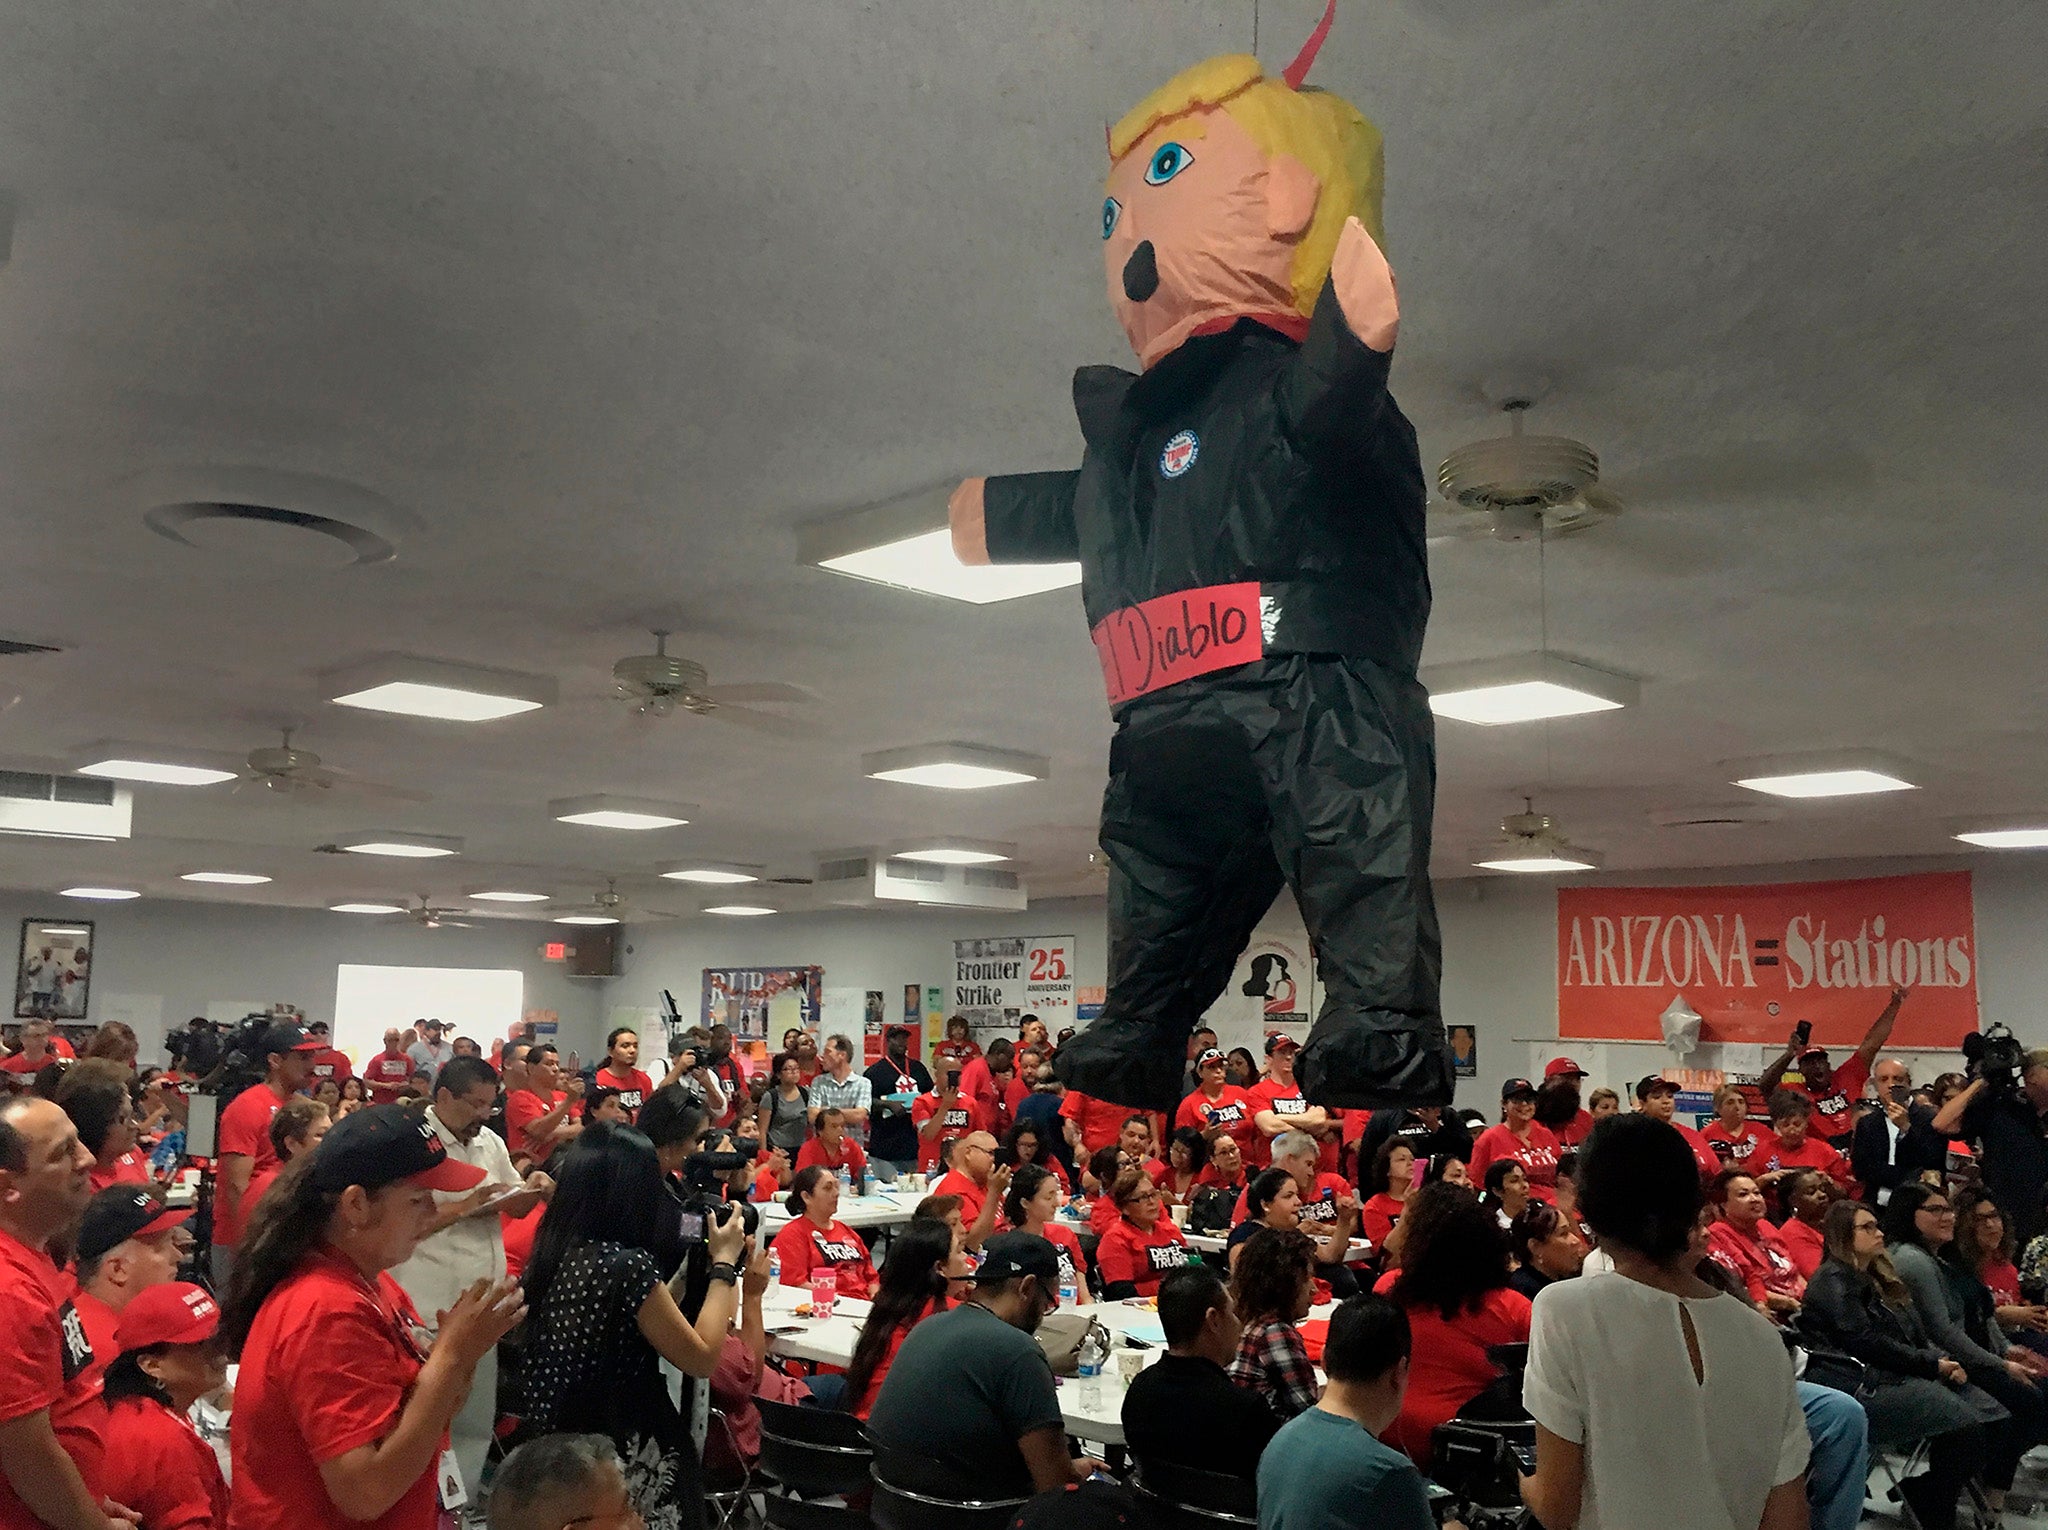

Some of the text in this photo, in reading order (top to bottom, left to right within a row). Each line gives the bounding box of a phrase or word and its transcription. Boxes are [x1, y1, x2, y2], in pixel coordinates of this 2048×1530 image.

[1118, 600, 1247, 692] Diablo
[956, 961, 1021, 981] Frontier
[1029, 948, 1066, 981] 25
[956, 985, 1002, 1006] Strike
[1027, 983, 1072, 992] ANNIVERSARY
